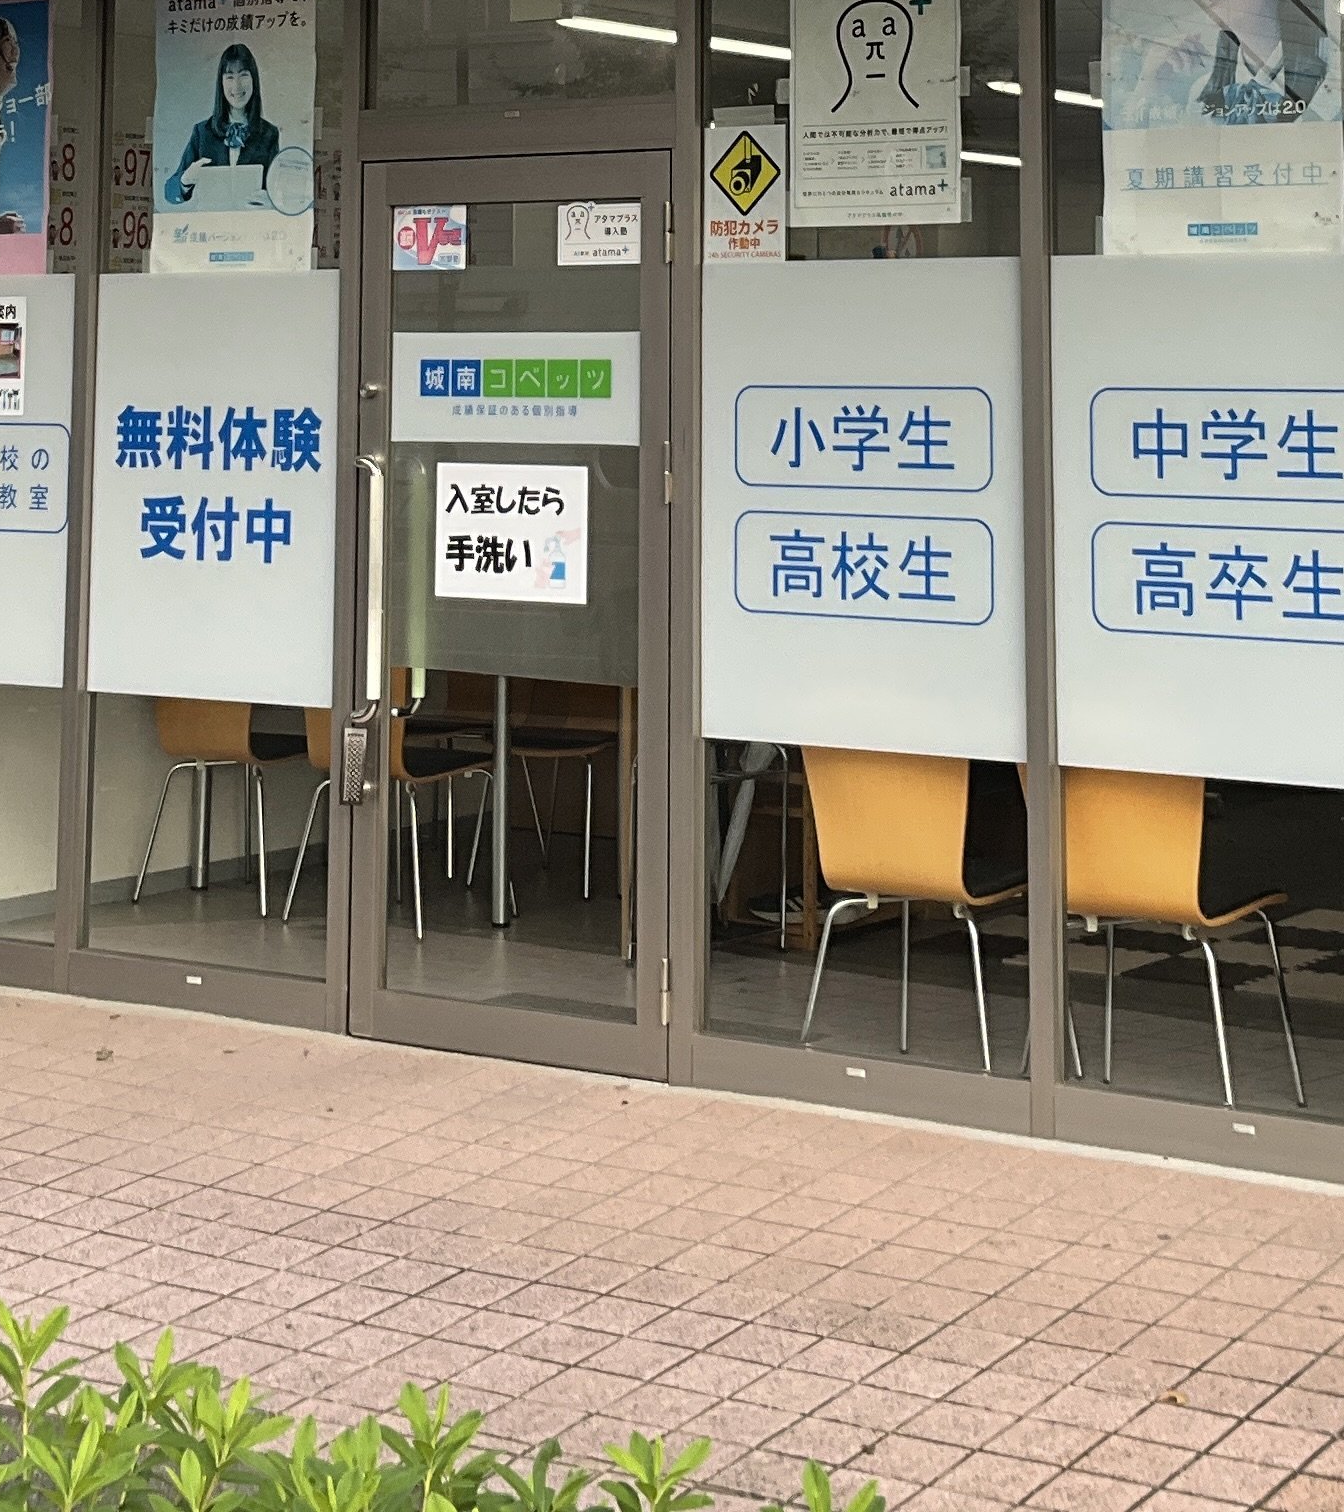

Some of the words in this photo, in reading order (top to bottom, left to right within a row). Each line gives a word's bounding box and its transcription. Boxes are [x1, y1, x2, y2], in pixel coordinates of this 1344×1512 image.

[167, 10, 307, 35] キミだけの成績アップを。
[1126, 161, 1323, 190] 夏期講習受付中
[710, 219, 779, 237] 防犯カメラ
[728, 237, 761, 250] 作動中
[425, 364, 605, 392] 城南コベッツ
[115, 404, 324, 473] 無料体験
[769, 403, 956, 473] 小学生
[1131, 407, 1344, 481] 中学生
[445, 483, 565, 516] 入室したら
[139, 494, 293, 565] 受付中
[445, 535, 532, 574] 手洗い
[769, 528, 957, 604] 高校生
